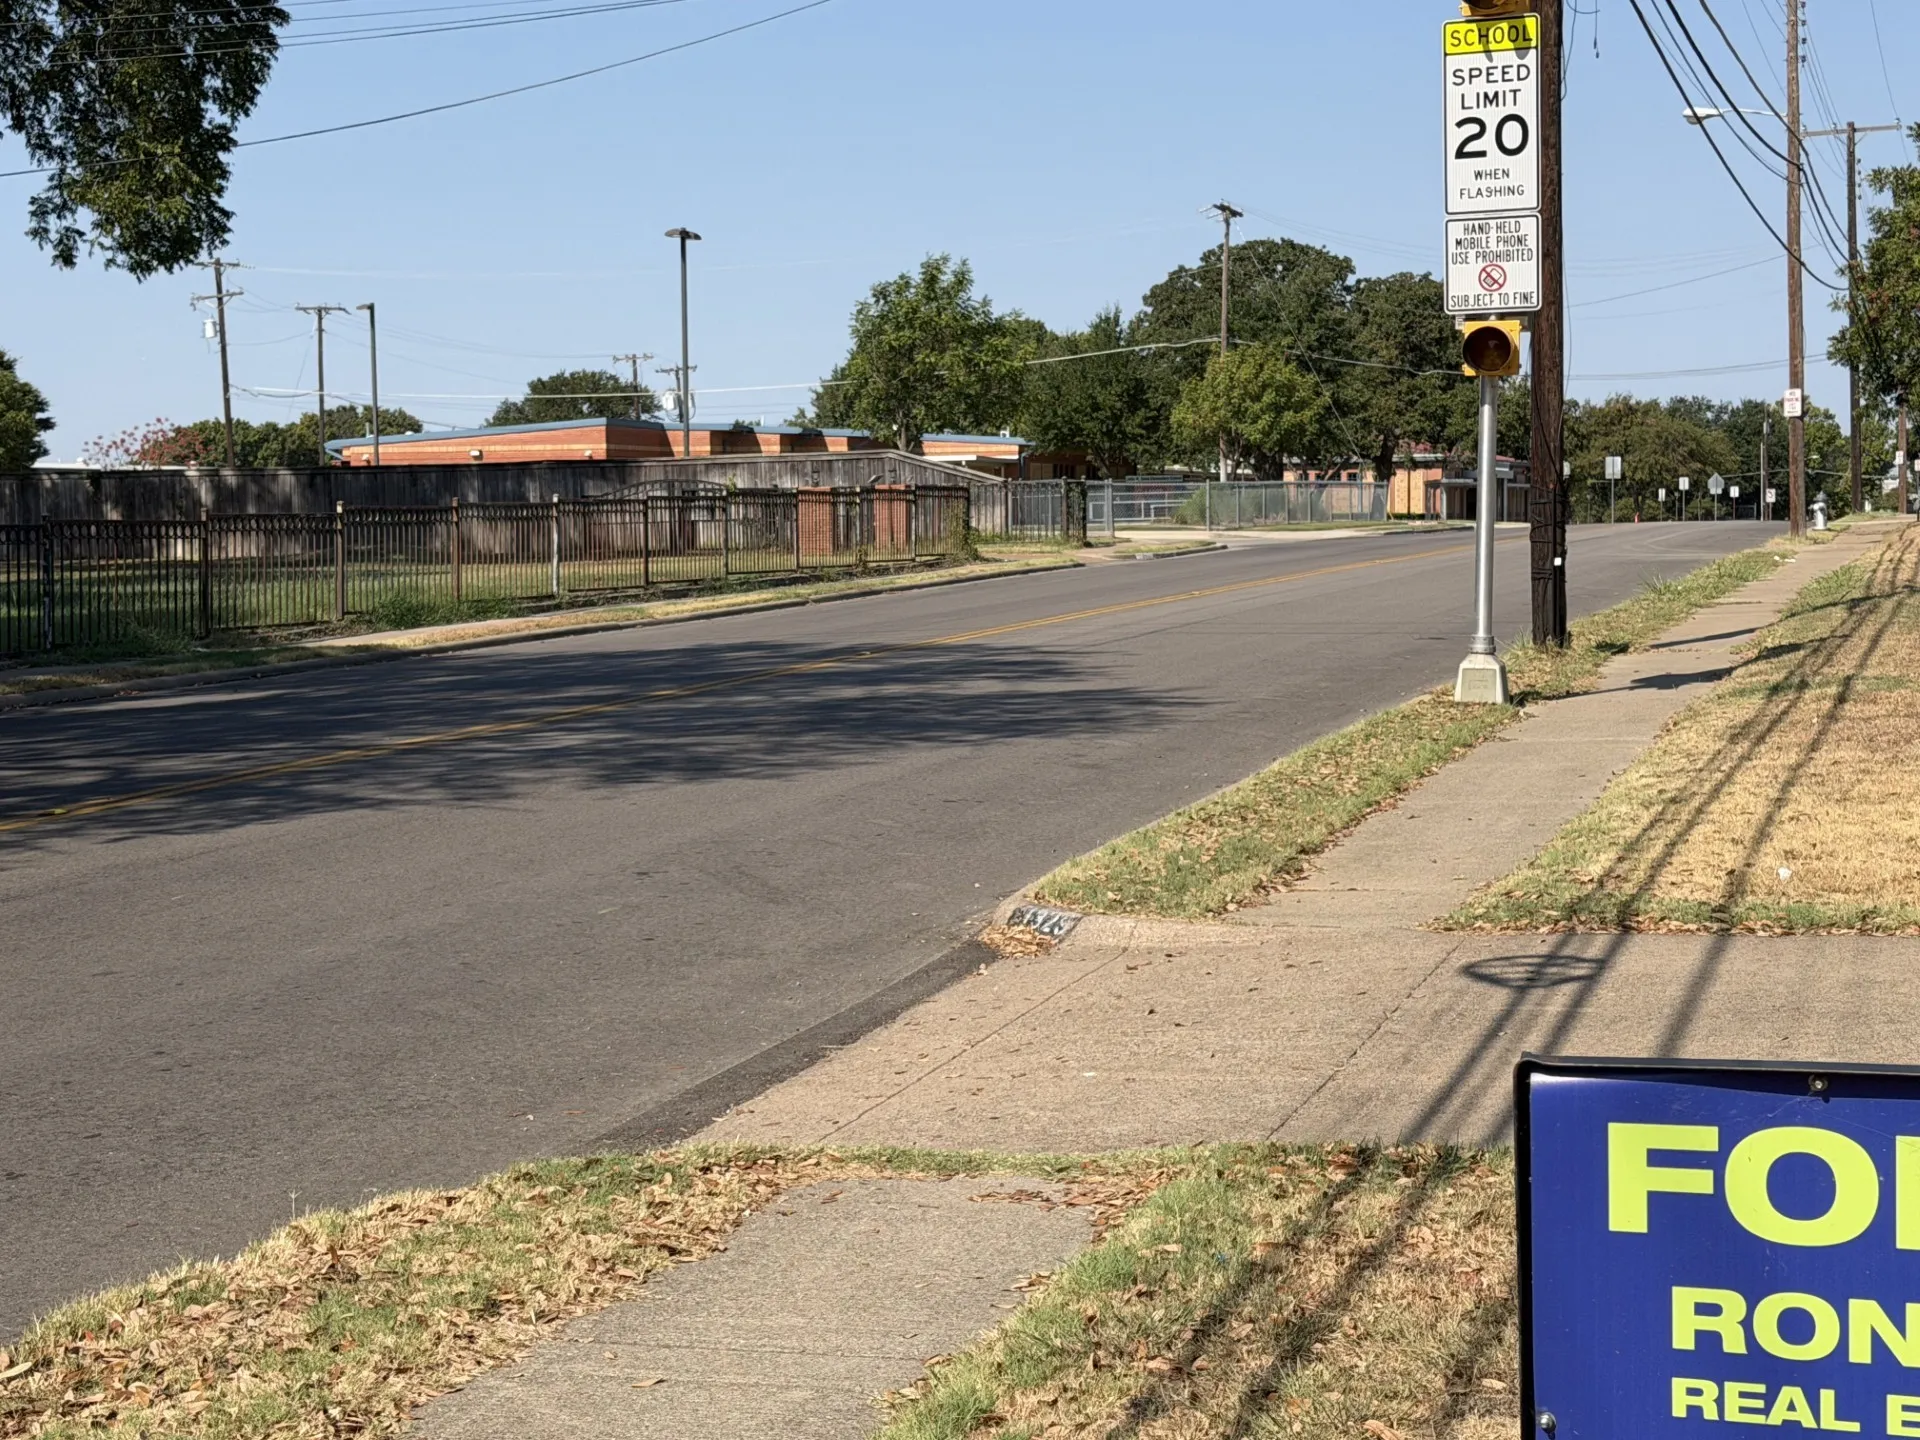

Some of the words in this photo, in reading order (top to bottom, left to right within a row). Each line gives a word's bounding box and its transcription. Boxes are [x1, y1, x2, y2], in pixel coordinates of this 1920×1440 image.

[1450, 24, 1532, 48] SCHOOL
[1452, 64, 1531, 86] SPEED
[1461, 89, 1521, 110] LIMIT
[1454, 113, 1529, 160] 20
[1473, 168, 1510, 181] WHEN
[1459, 184, 1525, 199] FLASHING
[1455, 236, 1492, 251] MOBILE
[1496, 234, 1529, 249] PHONE
[1451, 251, 1470, 265] USE
[1475, 248, 1534, 264] PROHIBITED
[1450, 293, 1494, 308] SUBJECT
[1498, 292, 1510, 306] TO
[1513, 291, 1535, 305] FINE
[1607, 1122, 1920, 1250] FO
[1671, 1285, 1920, 1368] RON
[1671, 1376, 1861, 1433] REAL
